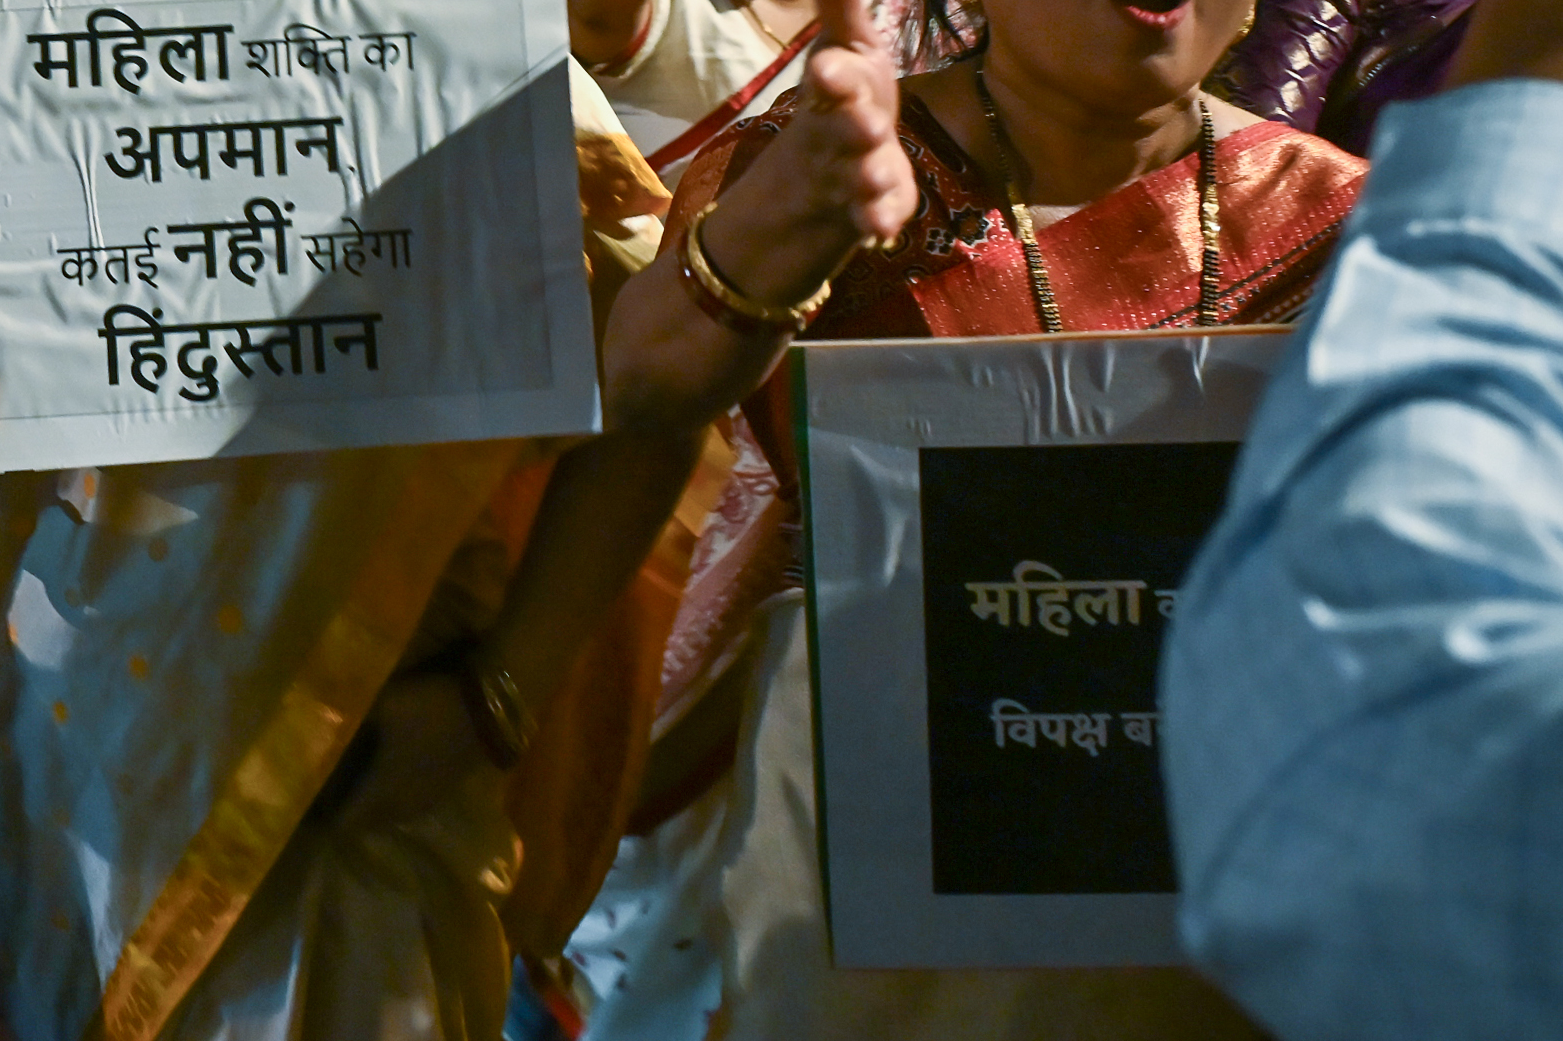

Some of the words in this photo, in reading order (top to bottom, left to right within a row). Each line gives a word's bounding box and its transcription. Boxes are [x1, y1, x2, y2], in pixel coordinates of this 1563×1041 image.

[26, 8, 234, 95] महिला
[241, 23, 351, 77] शक्ति
[359, 32, 417, 72] का
[56, 227, 161, 289] कतई
[167, 197, 296, 287] नहीं
[301, 217, 412, 276] सहेगा
[98, 304, 382, 402] हिंदुस्तान
[964, 560, 1147, 637] महिला
[991, 698, 1111, 757] विपक्ष
